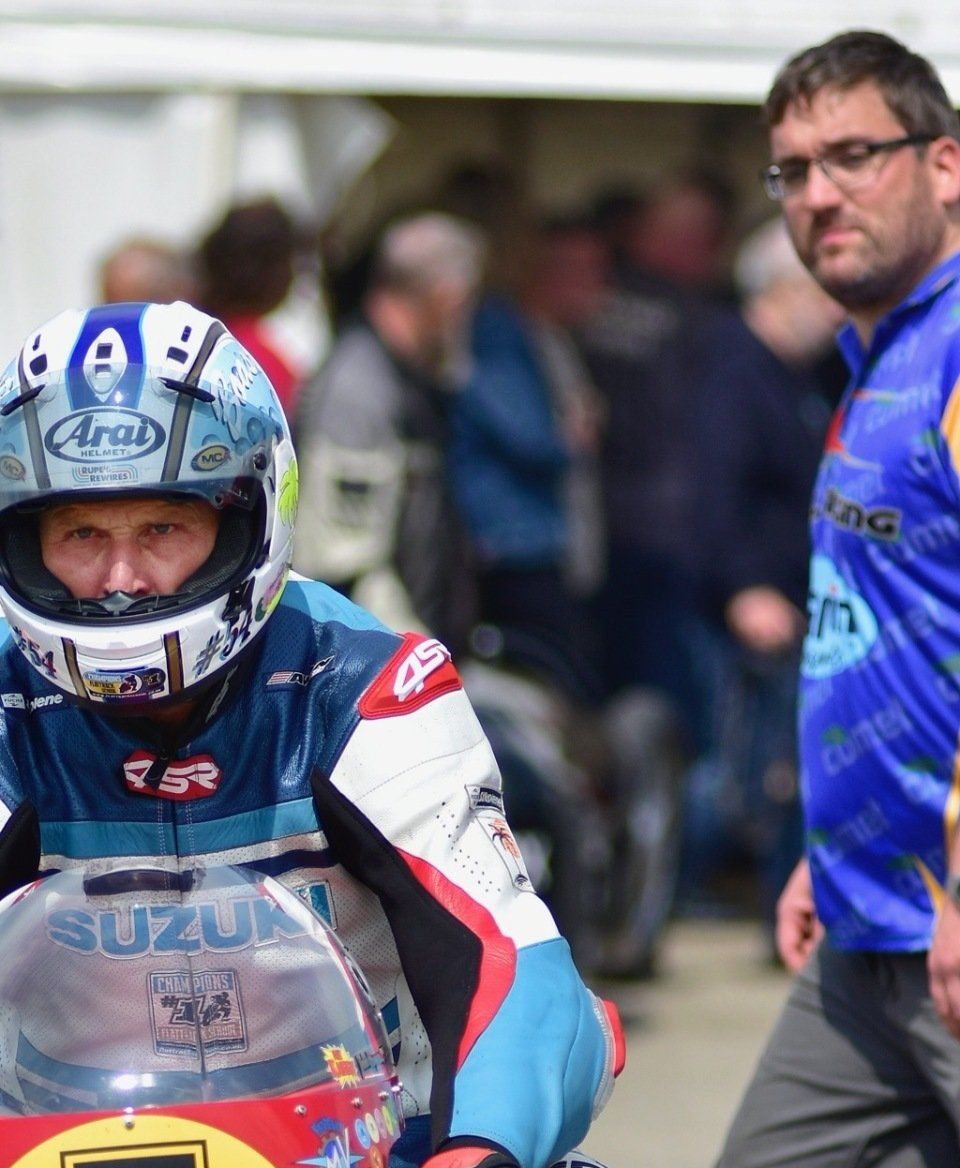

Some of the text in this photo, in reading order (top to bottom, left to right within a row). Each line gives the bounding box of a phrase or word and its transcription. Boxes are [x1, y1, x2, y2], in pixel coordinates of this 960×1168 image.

[50, 413, 152, 451] Arai
[80, 448, 127, 457] HELMET
[89, 472, 129, 482] REWIRES
